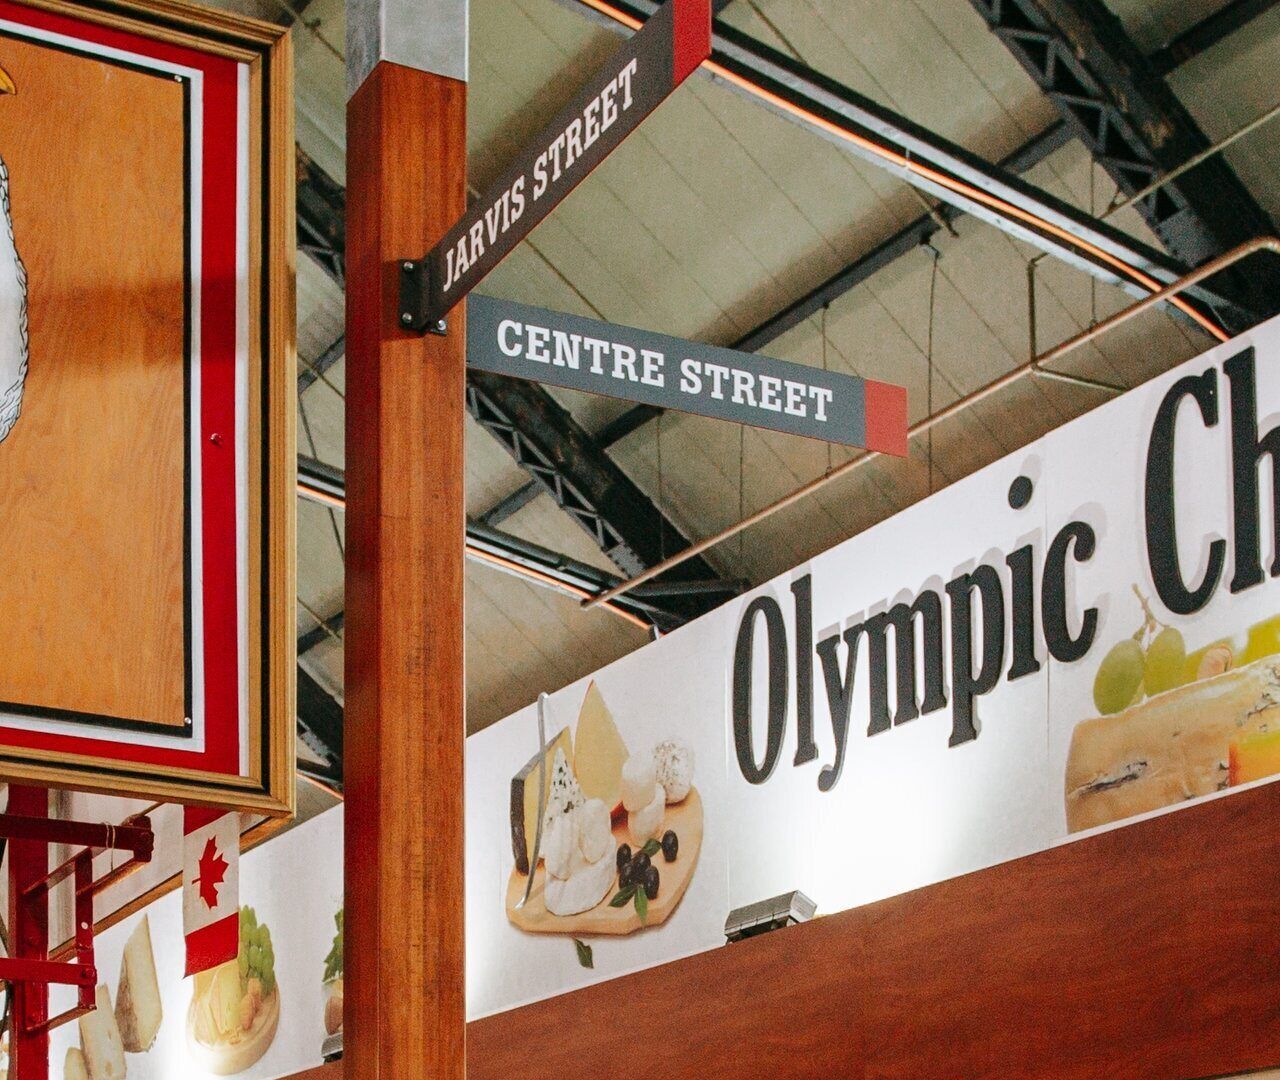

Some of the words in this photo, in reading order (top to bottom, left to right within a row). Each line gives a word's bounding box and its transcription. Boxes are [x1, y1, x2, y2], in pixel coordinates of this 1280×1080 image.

[442, 174, 526, 292] JARVIS
[532, 57, 638, 202] STREET
[497, 319, 665, 388] CENTRE
[680, 358, 834, 423] STREET
[731, 475, 1100, 793] Olympic
